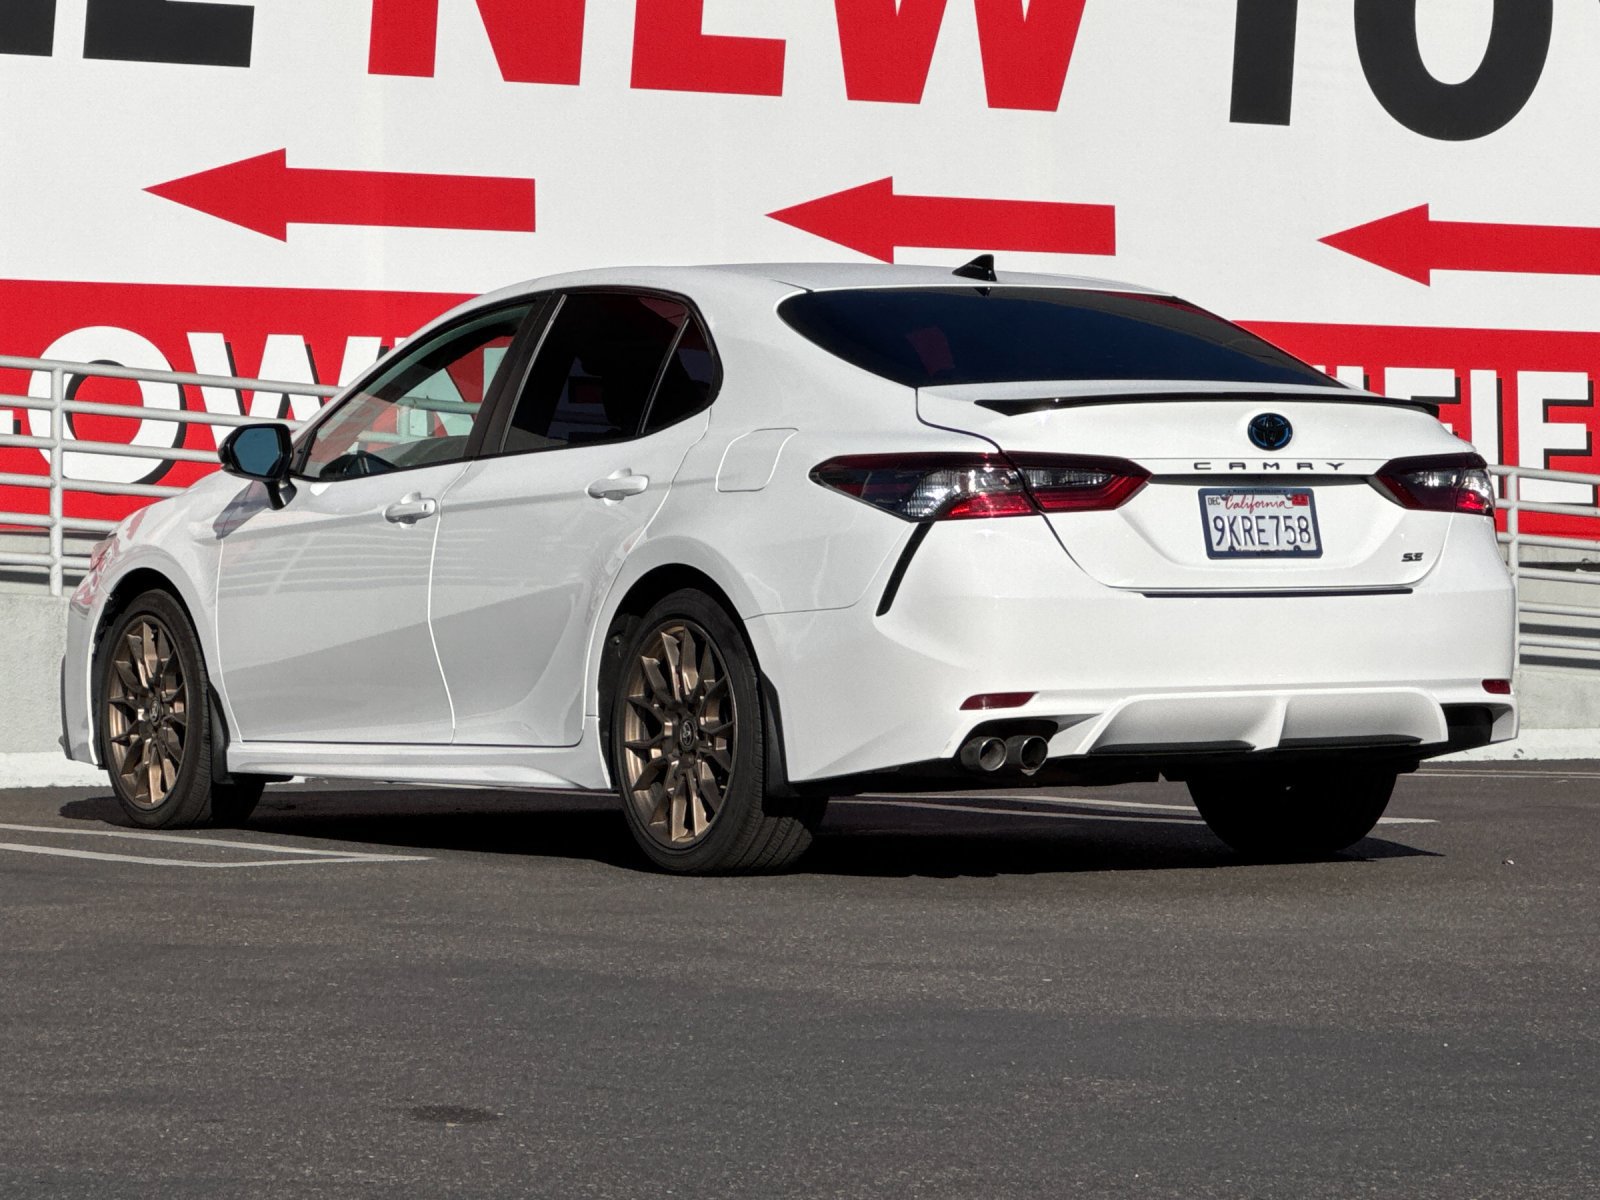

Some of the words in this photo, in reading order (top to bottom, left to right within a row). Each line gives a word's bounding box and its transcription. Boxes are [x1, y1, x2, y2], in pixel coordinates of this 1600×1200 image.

[1193, 462, 1345, 470] CAMRY
[1225, 494, 1294, 514] California
[1212, 515, 1312, 547] 9KRE758
[1401, 552, 1423, 562] SE
